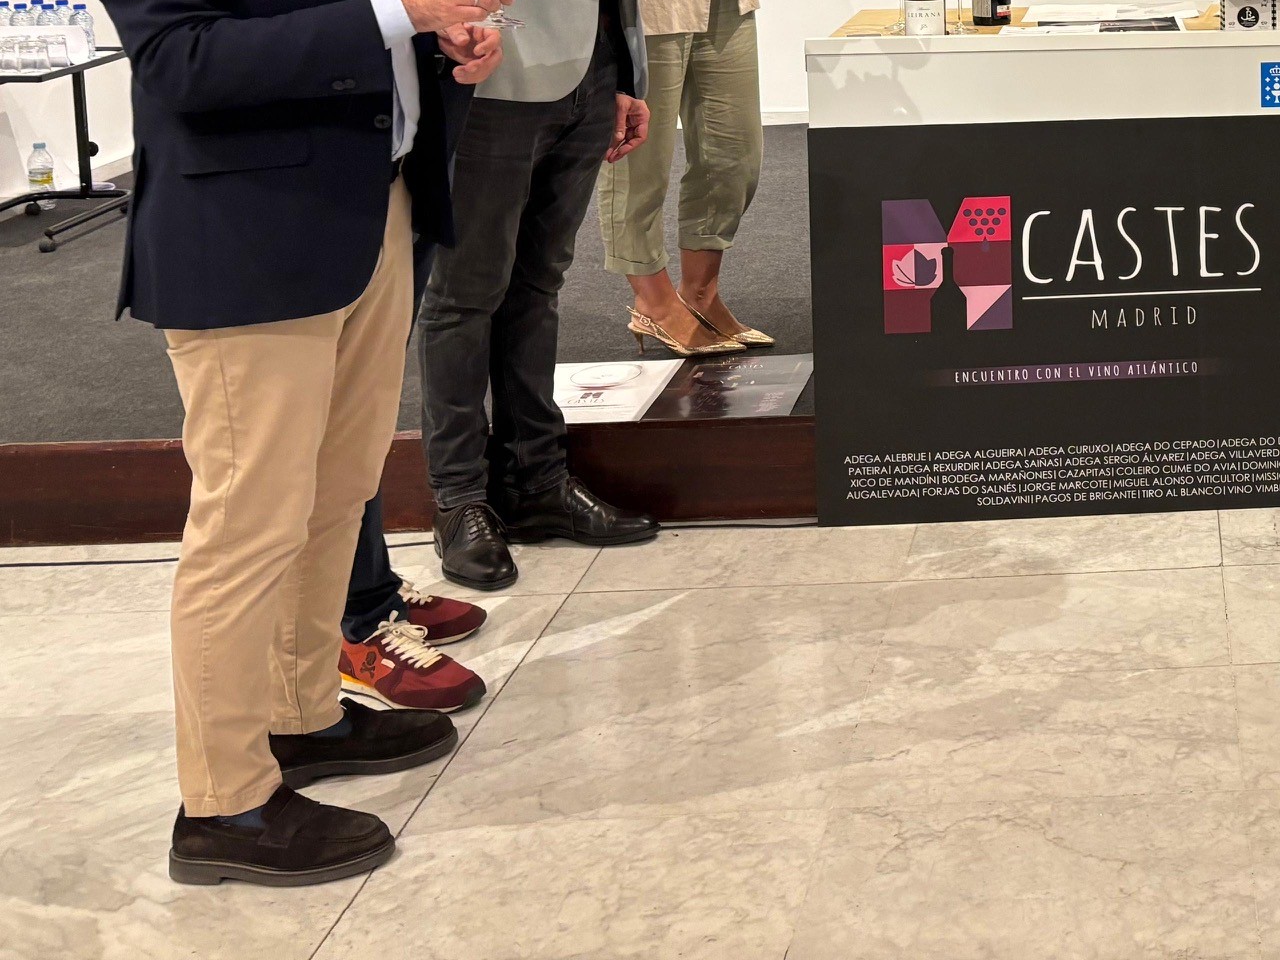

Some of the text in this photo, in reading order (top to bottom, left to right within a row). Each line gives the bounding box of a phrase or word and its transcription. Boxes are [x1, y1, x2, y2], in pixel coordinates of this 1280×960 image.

[1022, 203, 1261, 284] CASTES
[1091, 305, 1198, 329] MADRID
[954, 359, 1199, 384] ENCUENTRO CON EL VINO ATLÁNTICO
[844, 454, 880, 464] ADEGA
[884, 453, 926, 462] ALEBRIJE
[934, 451, 971, 460] ADEGA
[974, 449, 1022, 459] ALGUEIRA
[1028, 447, 1064, 456] ADEGA
[1067, 445, 1109, 455] CURUXO
[1115, 443, 1151, 453] ADEGA
[1153, 443, 1170, 451] DO
[1172, 441, 1215, 450] CEPADO
[1220, 439, 1256, 448] ADEGA
[1259, 438, 1275, 447] DO
[848, 465, 887, 474] PATEIRA
[893, 463, 930, 472] ADEGA
[932, 461, 979, 471] REXURDIR
[985, 459, 1022, 469] ADEGA
[1024, 456, 1058, 467] SAIÑAS
[1064, 456, 1100, 465] ADEGA
[1103, 454, 1139, 464] SERGIO
[1142, 450, 1184, 462] ÁLVAREZ
[1190, 451, 1226, 460] ADEGA
[846, 487, 918, 498] AUGALEVADA
[922, 486, 959, 495] FORJAS
[962, 485, 978, 494] DO
[981, 481, 1016, 493] SALNÉS
[1022, 482, 1056, 491] JORGE
[1058, 480, 1107, 490] MARCOTE
[1113, 478, 1149, 487] MIGUEL
[1152, 476, 1193, 486] ALONSO
[1196, 474, 1250, 484] VITICULTOR
[850, 477, 875, 486] XICO
[878, 476, 891, 485] DE
[894, 472, 936, 484] MANDÍN
[941, 473, 985, 482] BODEGA
[988, 468, 1052, 480] MARAÑONES
[1058, 468, 1110, 478] CAZAPITAS
[1116, 466, 1159, 475] COLEIRO
[1162, 464, 1191, 473] CUME
[1193, 464, 1210, 472] DO
[1212, 462, 1236, 471] AVIA
[977, 495, 1030, 505] SOLDAVINI
[1035, 493, 1071, 503] PAGOS
[1073, 492, 1086, 501] DE
[1089, 490, 1136, 500] BRIGANTE
[1142, 489, 1163, 498] TIRO
[1166, 489, 1177, 497] AL
[1180, 487, 1222, 497] BLANCO
[1227, 486, 1252, 495] VINO
